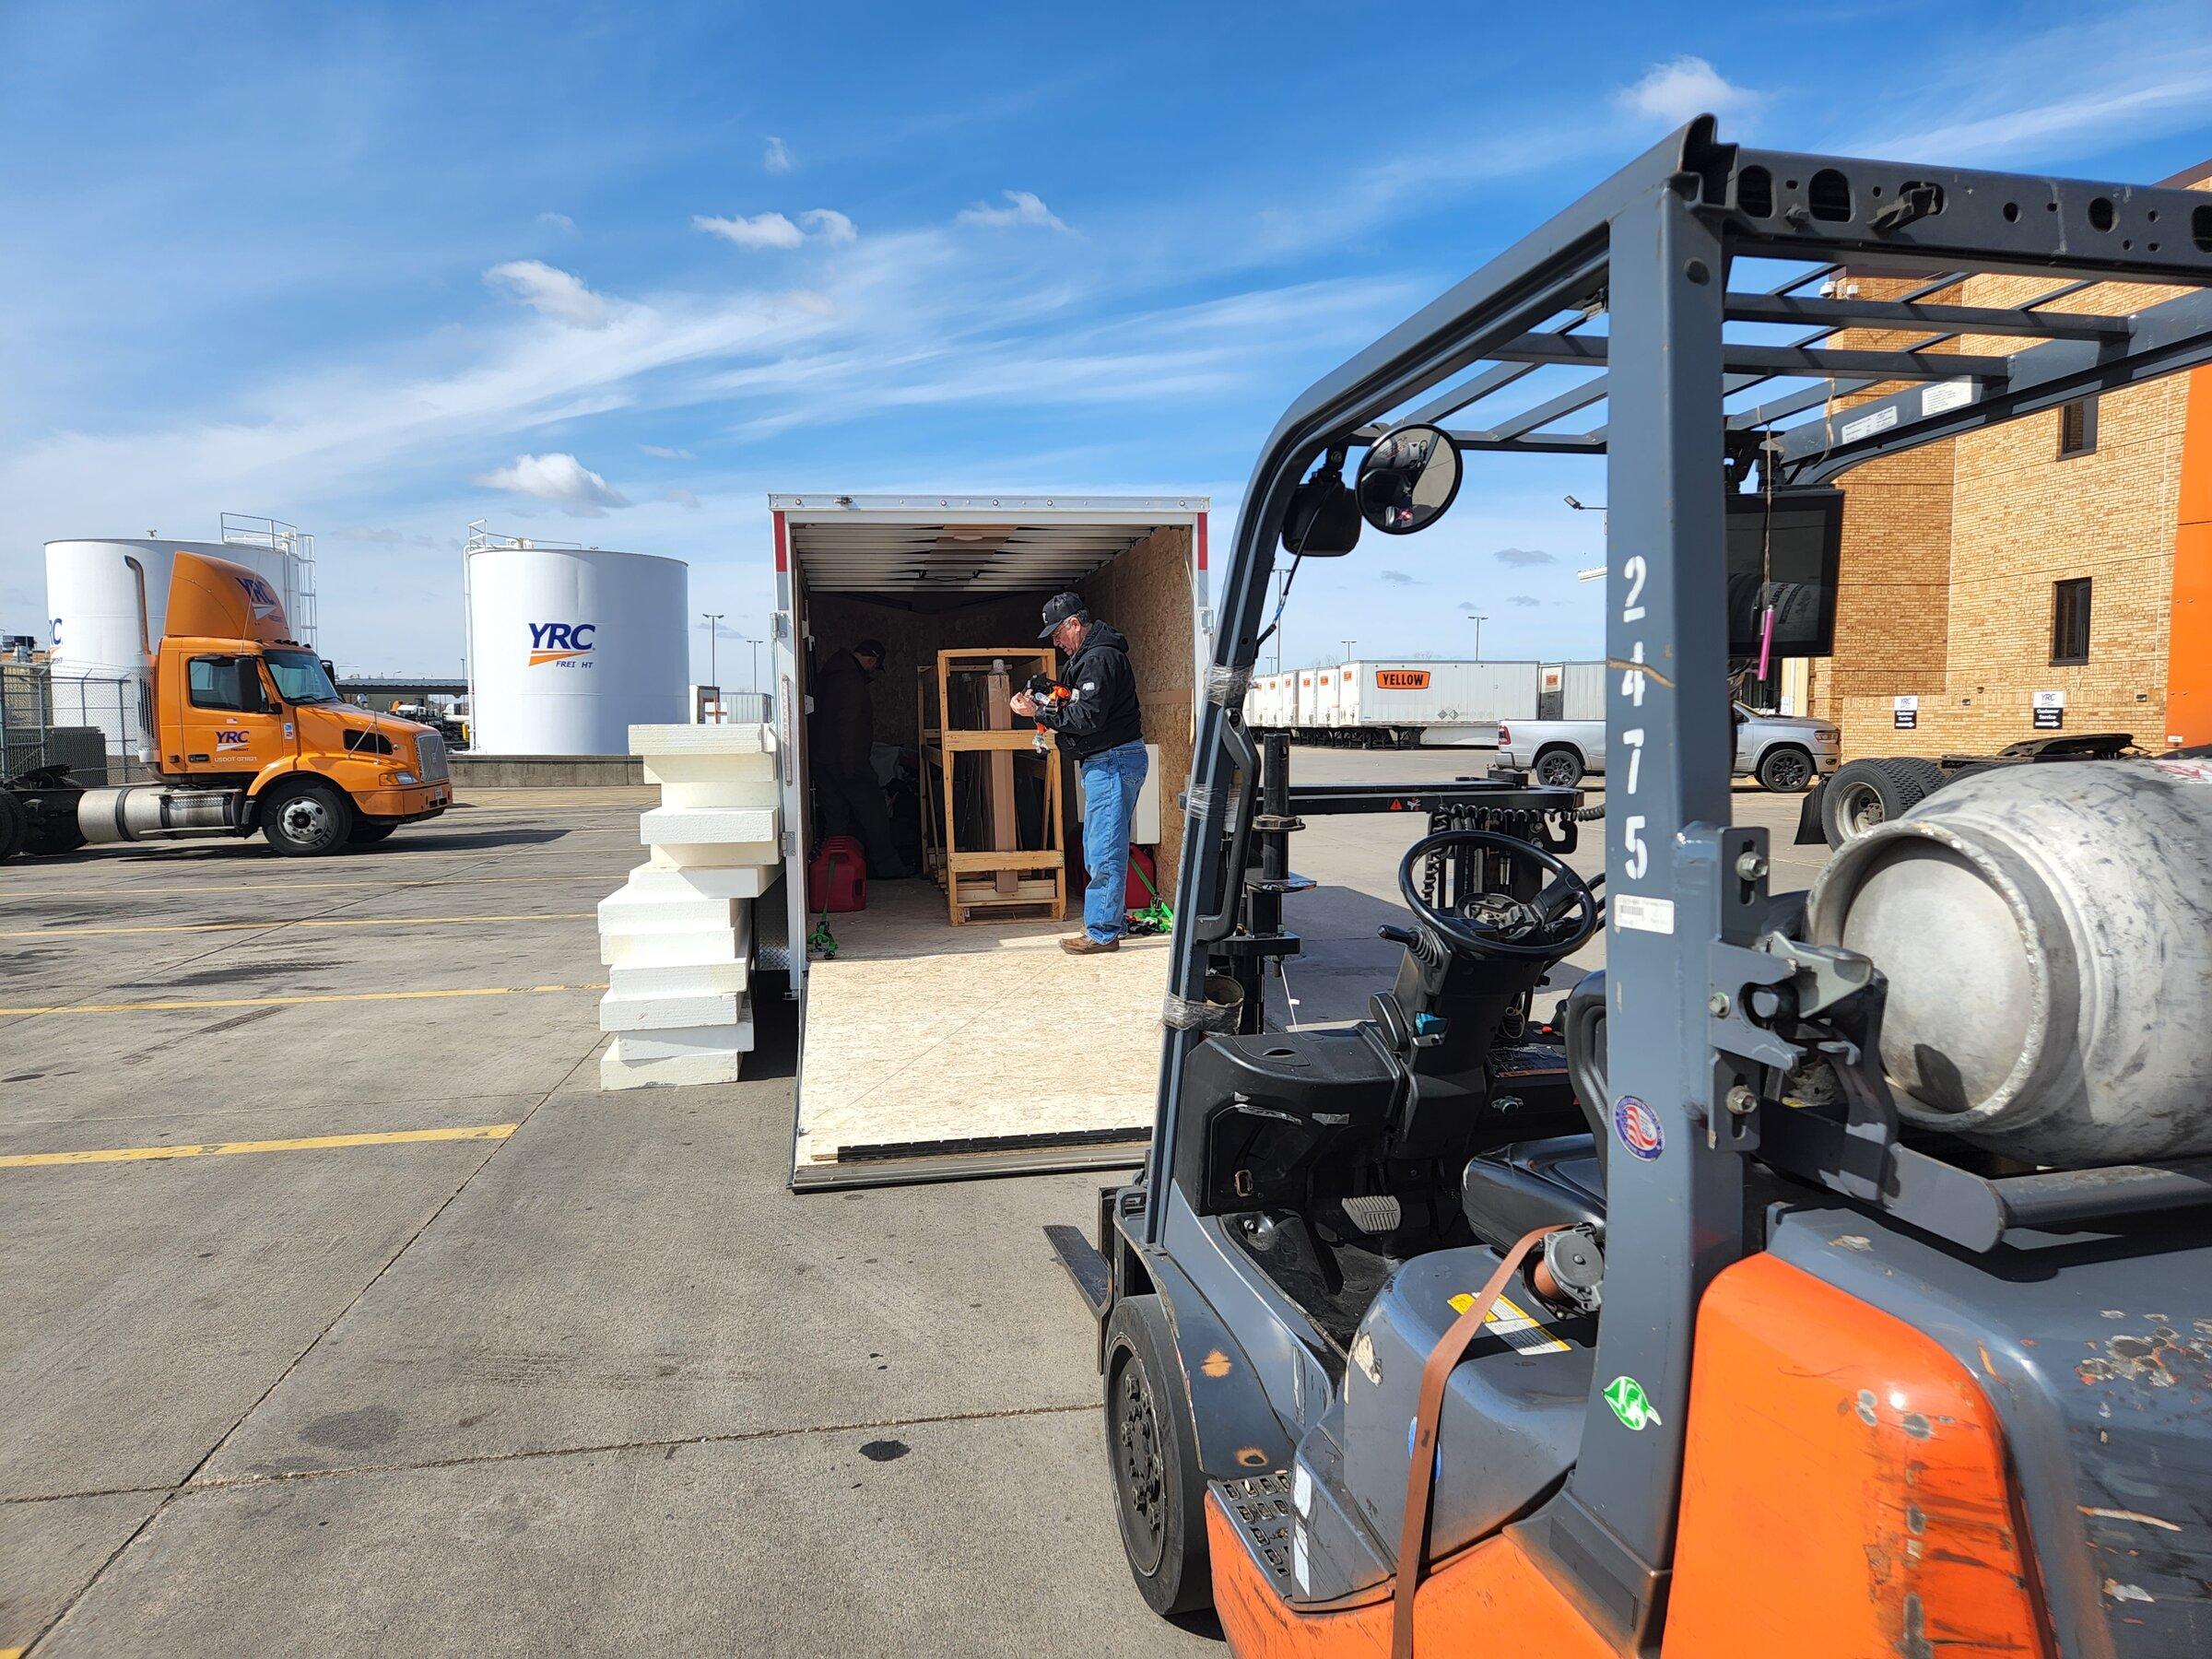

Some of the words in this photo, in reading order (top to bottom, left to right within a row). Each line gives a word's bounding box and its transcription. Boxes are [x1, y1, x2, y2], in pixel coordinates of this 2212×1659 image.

[235, 577, 276, 606] YRC
[528, 623, 596, 650] YRC
[556, 660, 594, 668] FREIHT
[1383, 674, 1424, 686] YELLOW
[2041, 693, 2056, 701] YRC
[216, 730, 250, 744] YRC
